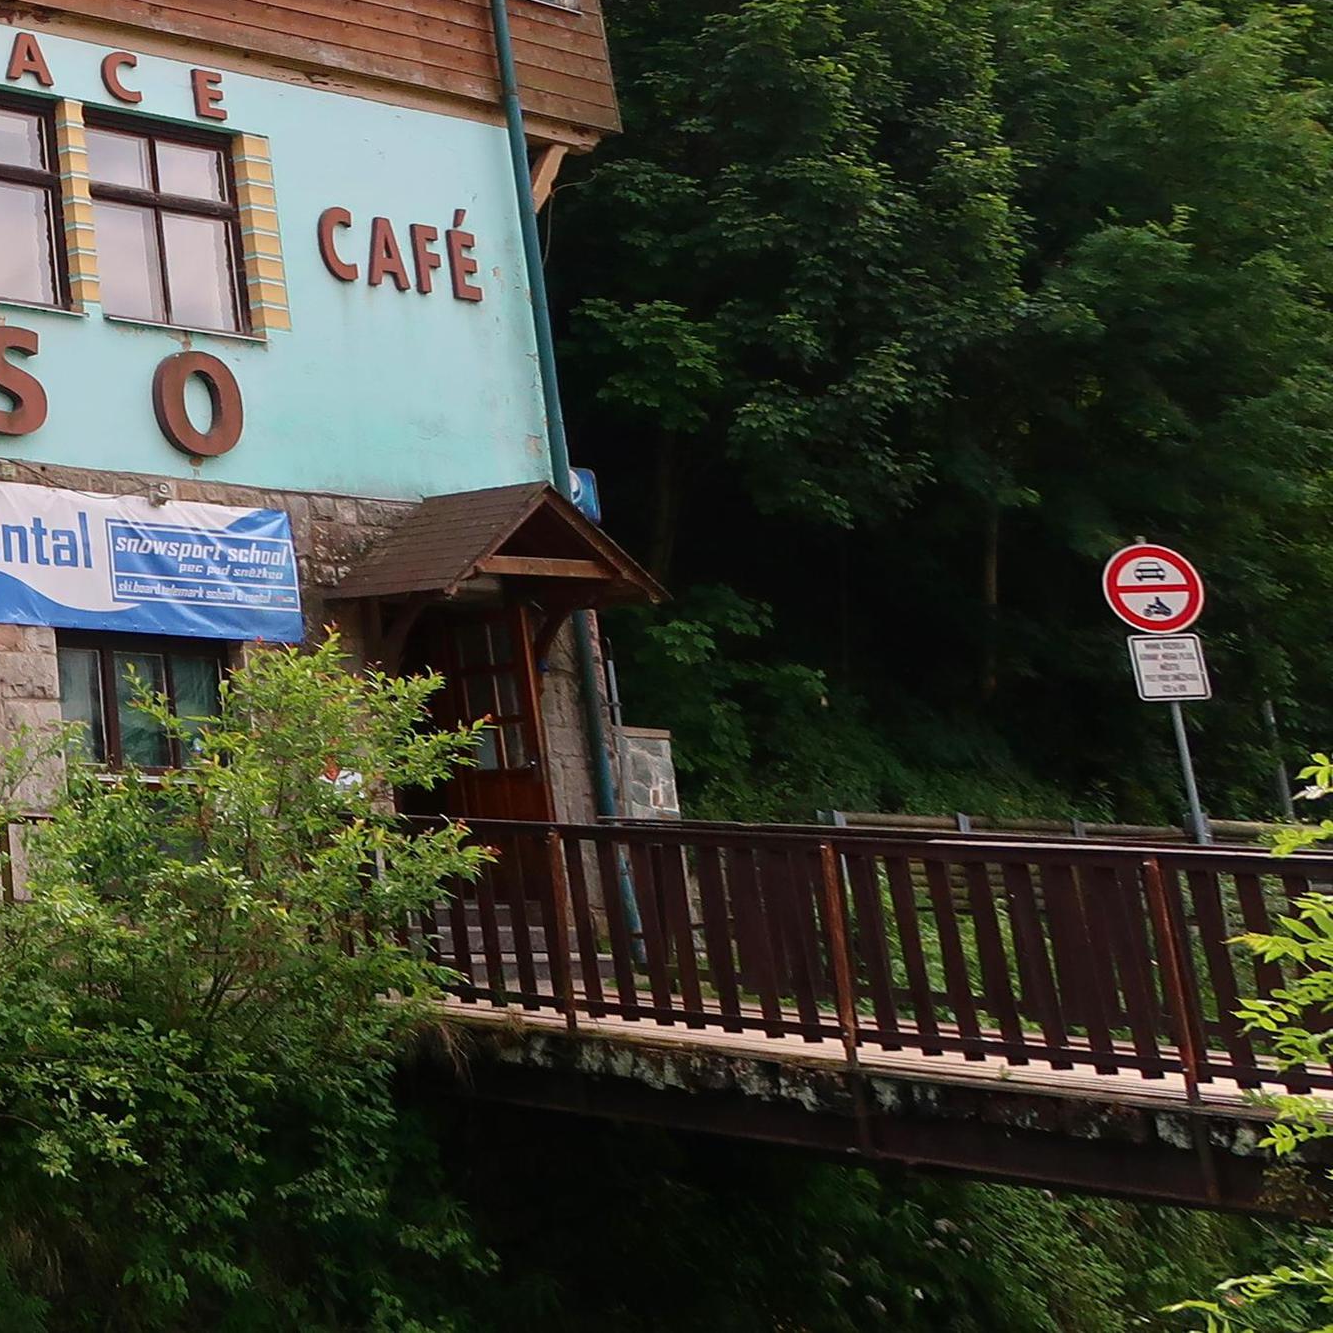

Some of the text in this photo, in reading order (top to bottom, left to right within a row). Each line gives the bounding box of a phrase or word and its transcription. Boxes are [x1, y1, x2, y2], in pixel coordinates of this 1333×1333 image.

[317, 206, 484, 303] CAFÉ
[115, 536, 289, 567] snowsport school
